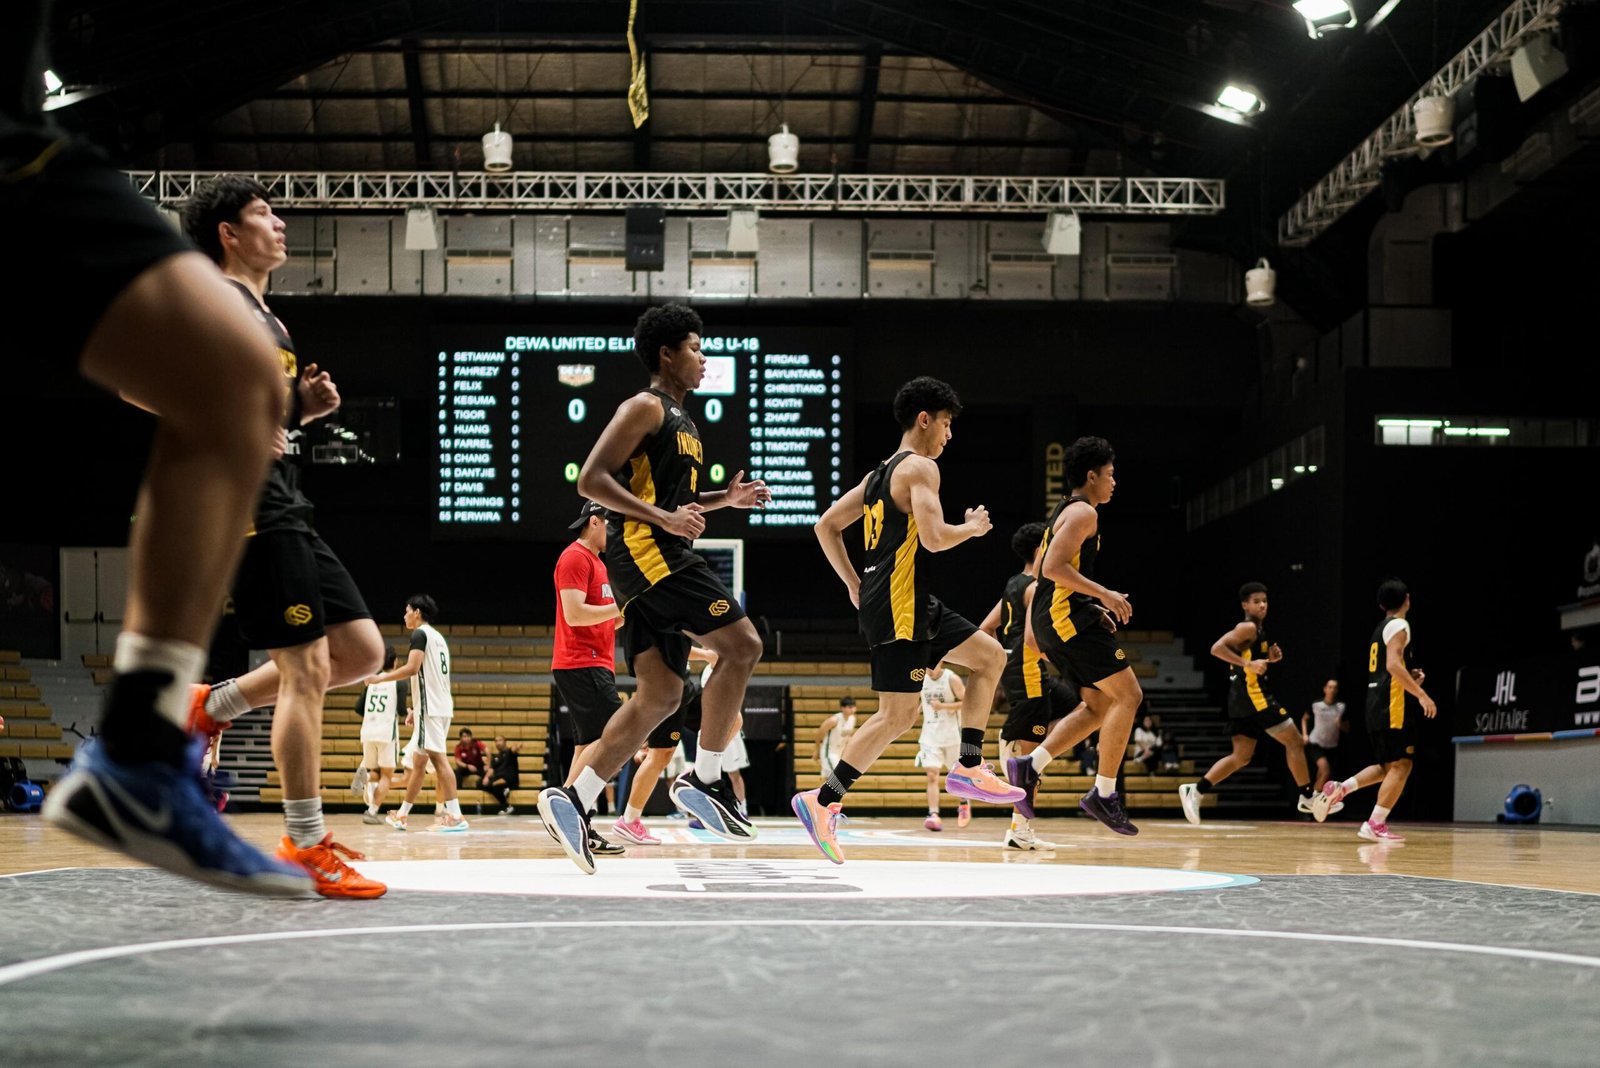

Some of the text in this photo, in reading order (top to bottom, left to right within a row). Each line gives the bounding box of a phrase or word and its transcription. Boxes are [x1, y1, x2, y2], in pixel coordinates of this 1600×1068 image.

[505, 336, 550, 351] DEWA
[551, 336, 606, 351] UNITED
[607, 336, 635, 351] ELIT
[726, 336, 760, 351] U-18
[438, 351, 520, 363] 0 SETIAWAN 0
[750, 354, 758, 365] 1
[764, 353, 810, 366] FIRDAUS
[438, 365, 520, 378] 2 FAHREZY 0
[749, 368, 758, 380] 2
[453, 380, 483, 392] FELIX
[511, 380, 520, 392] 0
[749, 382, 758, 394] 7
[763, 383, 827, 395] CHRISTIANO
[438, 394, 520, 406] 7 KESUMA 0
[764, 397, 804, 409] KOVITH
[453, 409, 486, 421] TIGOR
[511, 409, 520, 421] 0
[567, 398, 586, 422] 0
[704, 398, 723, 422] 0
[438, 423, 520, 435] 9 HUANG 0
[749, 426, 763, 438] 12
[439, 438, 520, 450] 10 FARREL 0
[763, 441, 810, 453] TIMOTHY
[439, 452, 520, 464] 13 CHANG 0
[763, 455, 806, 467] NATHAN
[453, 467, 496, 479] DANTJIE
[511, 467, 520, 479] 0
[564, 462, 579, 482] 0
[709, 463, 725, 483] 0
[749, 470, 763, 481] 17
[763, 470, 813, 481] ORLEANS
[1045, 442, 1065, 518] NITED
[439, 481, 520, 493] 17 DAVIS 0
[453, 496, 505, 508] JENNINGS
[511, 496, 520, 508] 0
[453, 510, 501, 522] PERWIRA
[511, 511, 520, 522] 0
[748, 513, 763, 525] 20
[1368, 641, 1379, 673] 8
[439, 651, 449, 676] 8
[1490, 670, 1518, 706] JHL
